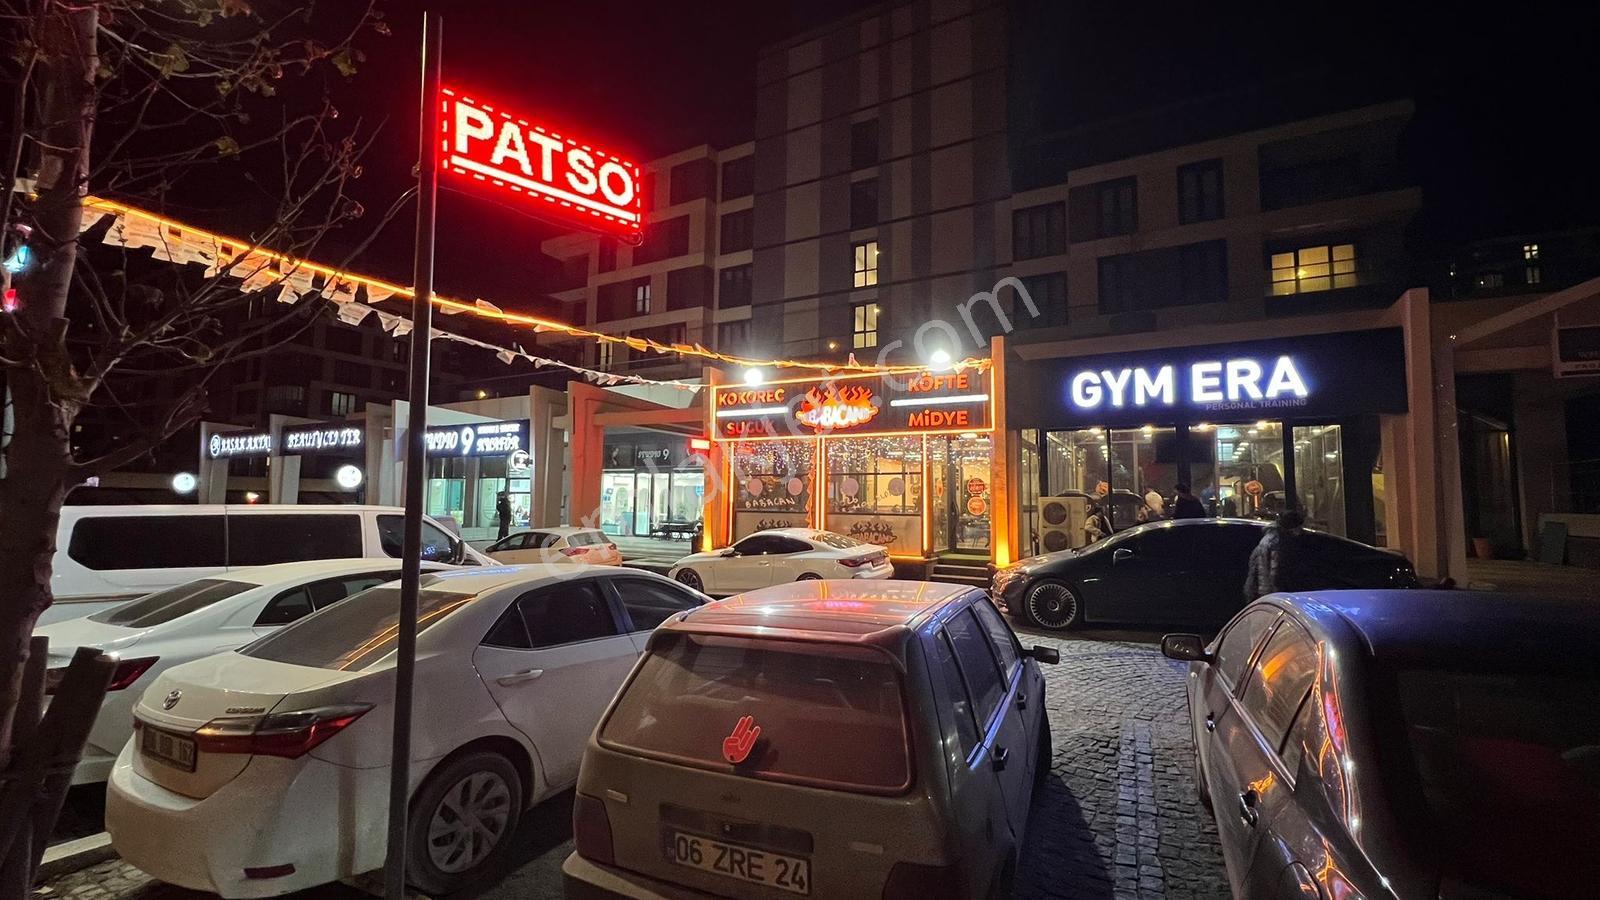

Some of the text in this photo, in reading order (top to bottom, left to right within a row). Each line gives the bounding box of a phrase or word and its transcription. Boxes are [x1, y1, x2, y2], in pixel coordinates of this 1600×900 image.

[455, 101, 635, 206] PATSO
[908, 371, 968, 392] KÖFTE
[1072, 355, 1308, 408] GYM ERA
[1205, 398, 1307, 411] PERSONAL TRAINING
[726, 420, 775, 435] SUCUK
[287, 430, 323, 449] BEAUTY
[461, 427, 474, 454] 9
[662, 448, 670, 460] 9
[676, 835, 806, 891] 06 ZRE 24
